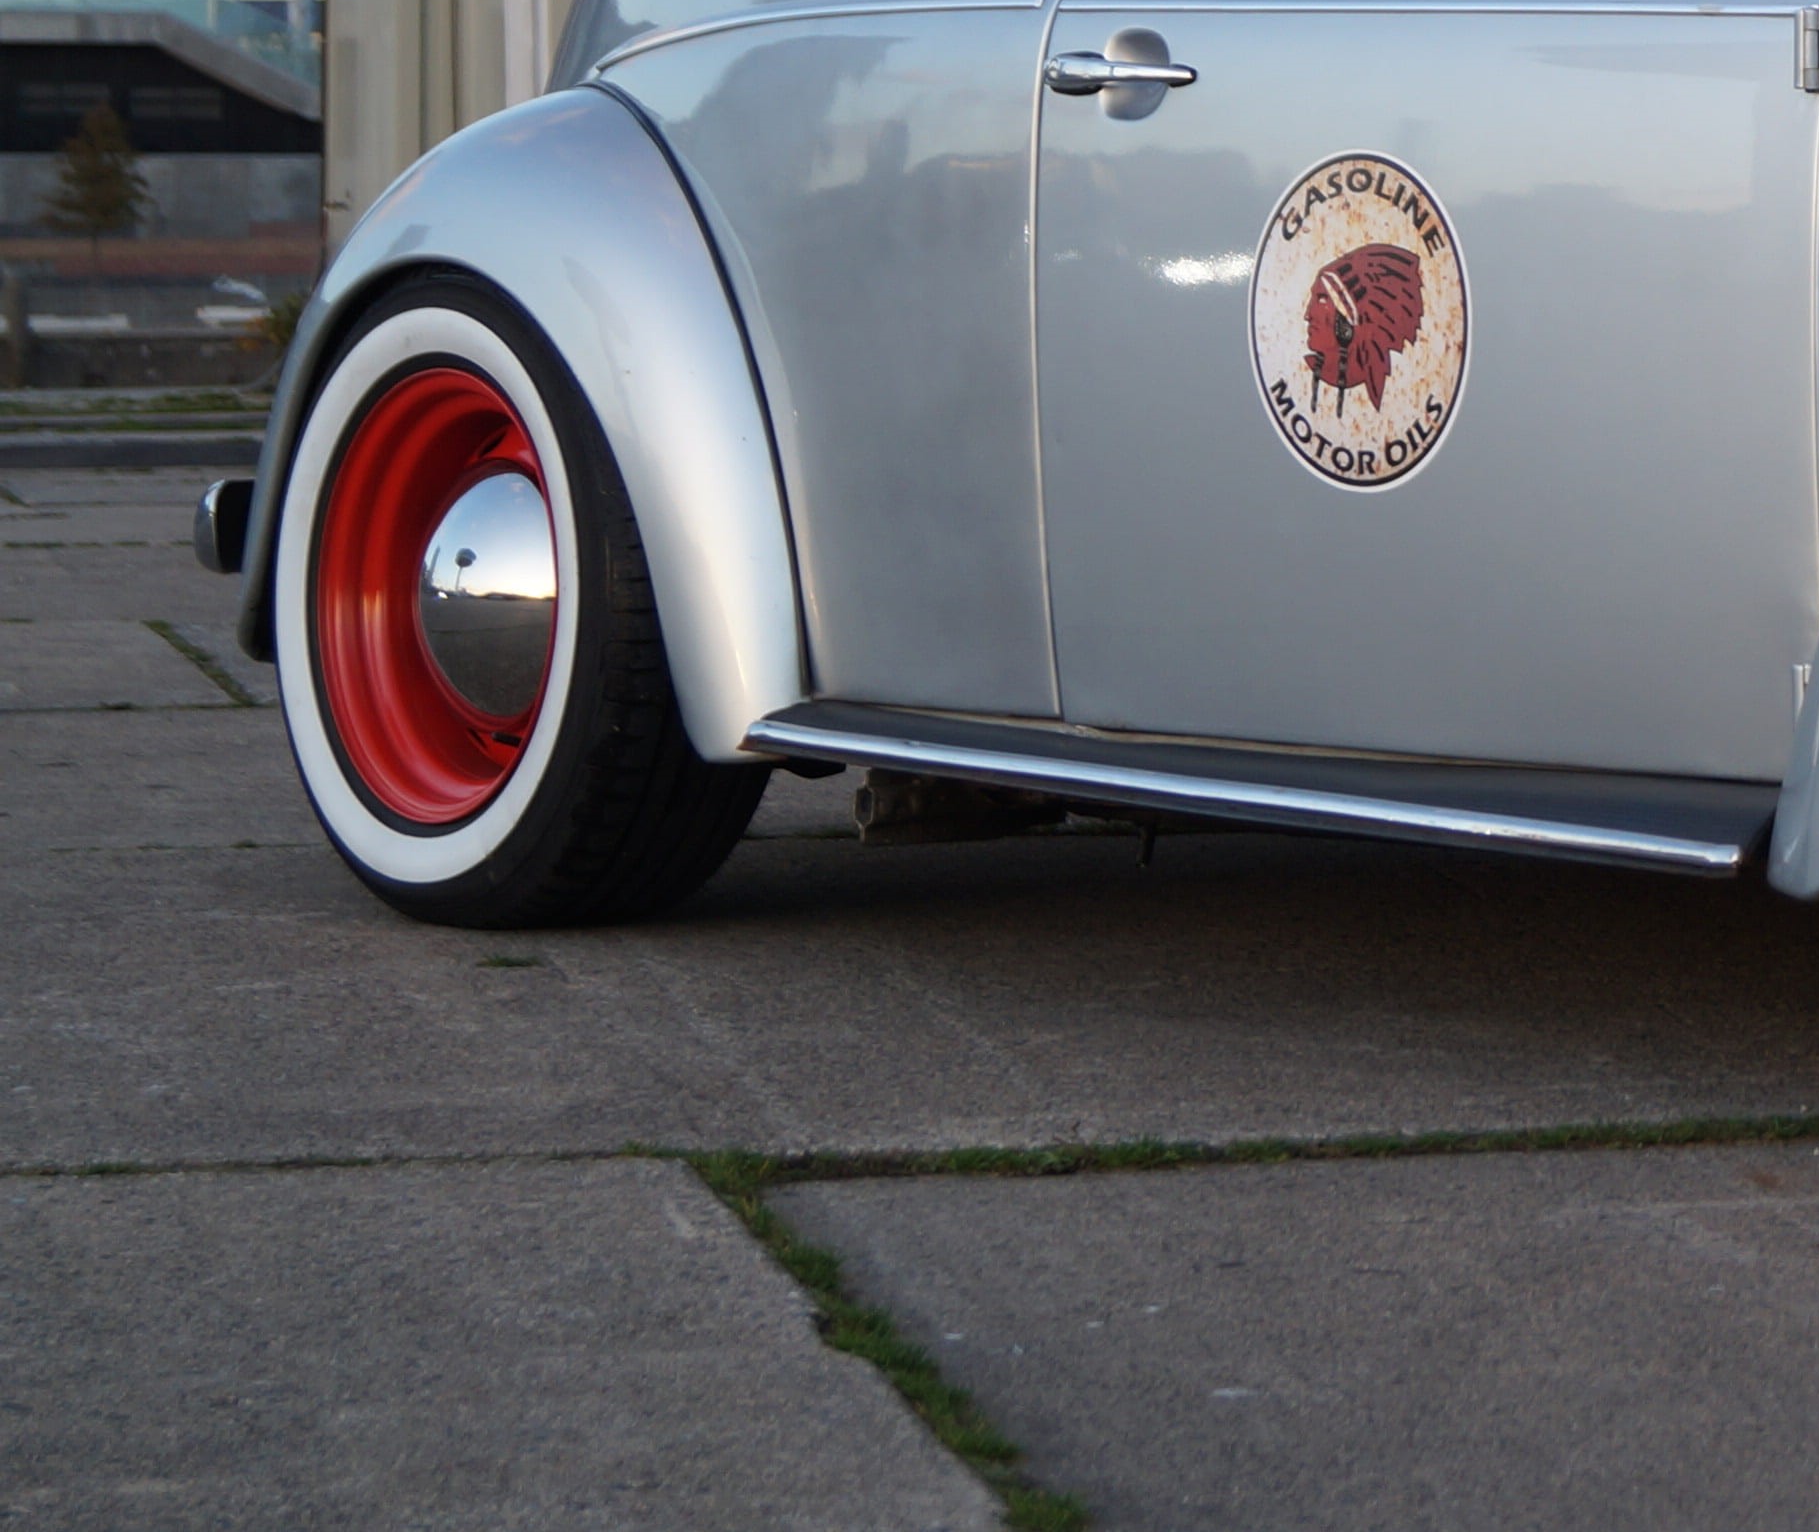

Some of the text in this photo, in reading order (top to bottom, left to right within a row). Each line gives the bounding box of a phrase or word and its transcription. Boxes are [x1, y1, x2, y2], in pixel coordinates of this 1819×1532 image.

[1281, 167, 1446, 259] GASOLINE
[1270, 377, 1444, 475] MOTOR OILS
